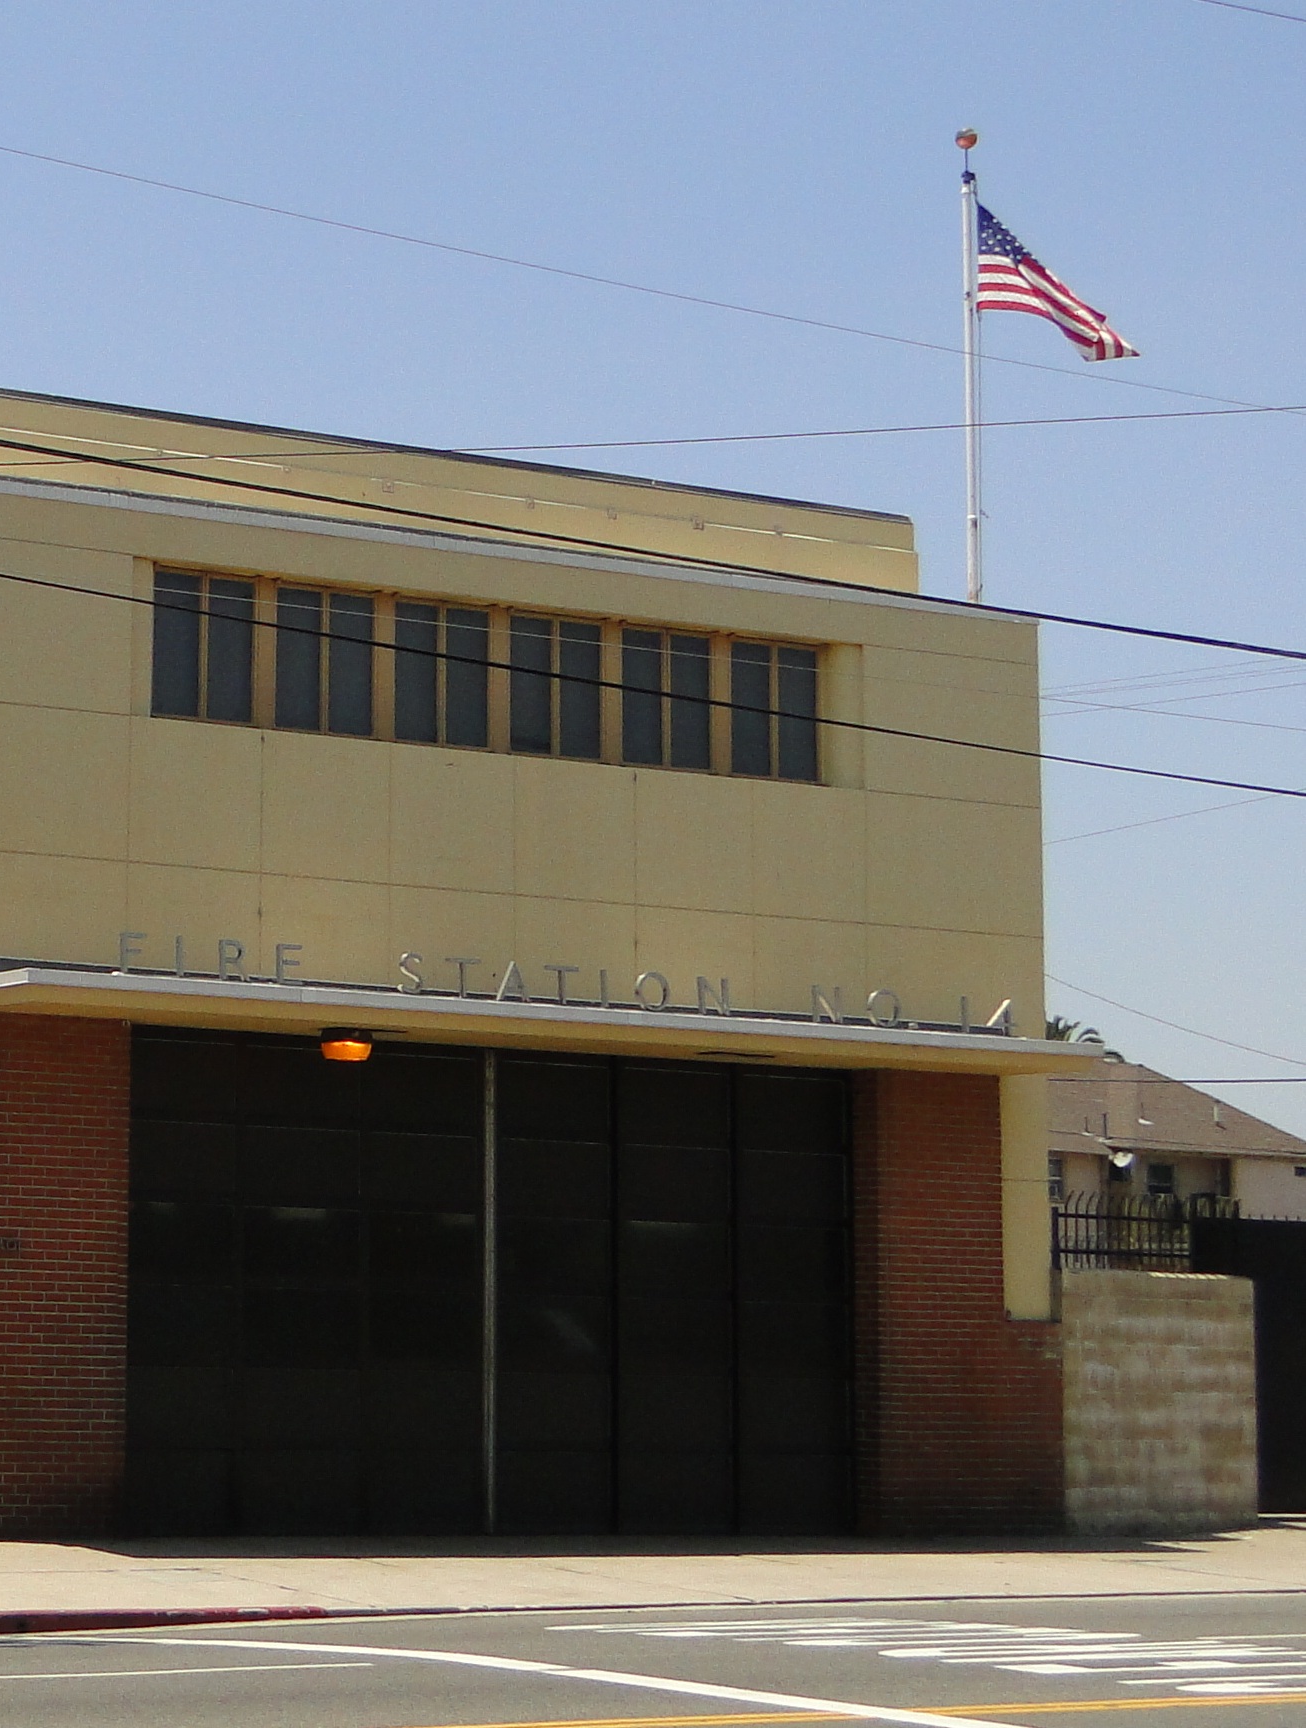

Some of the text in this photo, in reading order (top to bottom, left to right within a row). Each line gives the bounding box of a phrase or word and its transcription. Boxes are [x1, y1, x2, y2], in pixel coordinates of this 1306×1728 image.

[119, 932, 303, 984] FIRE
[397, 951, 730, 1016] STATION
[961, 996, 1016, 1037] 14
